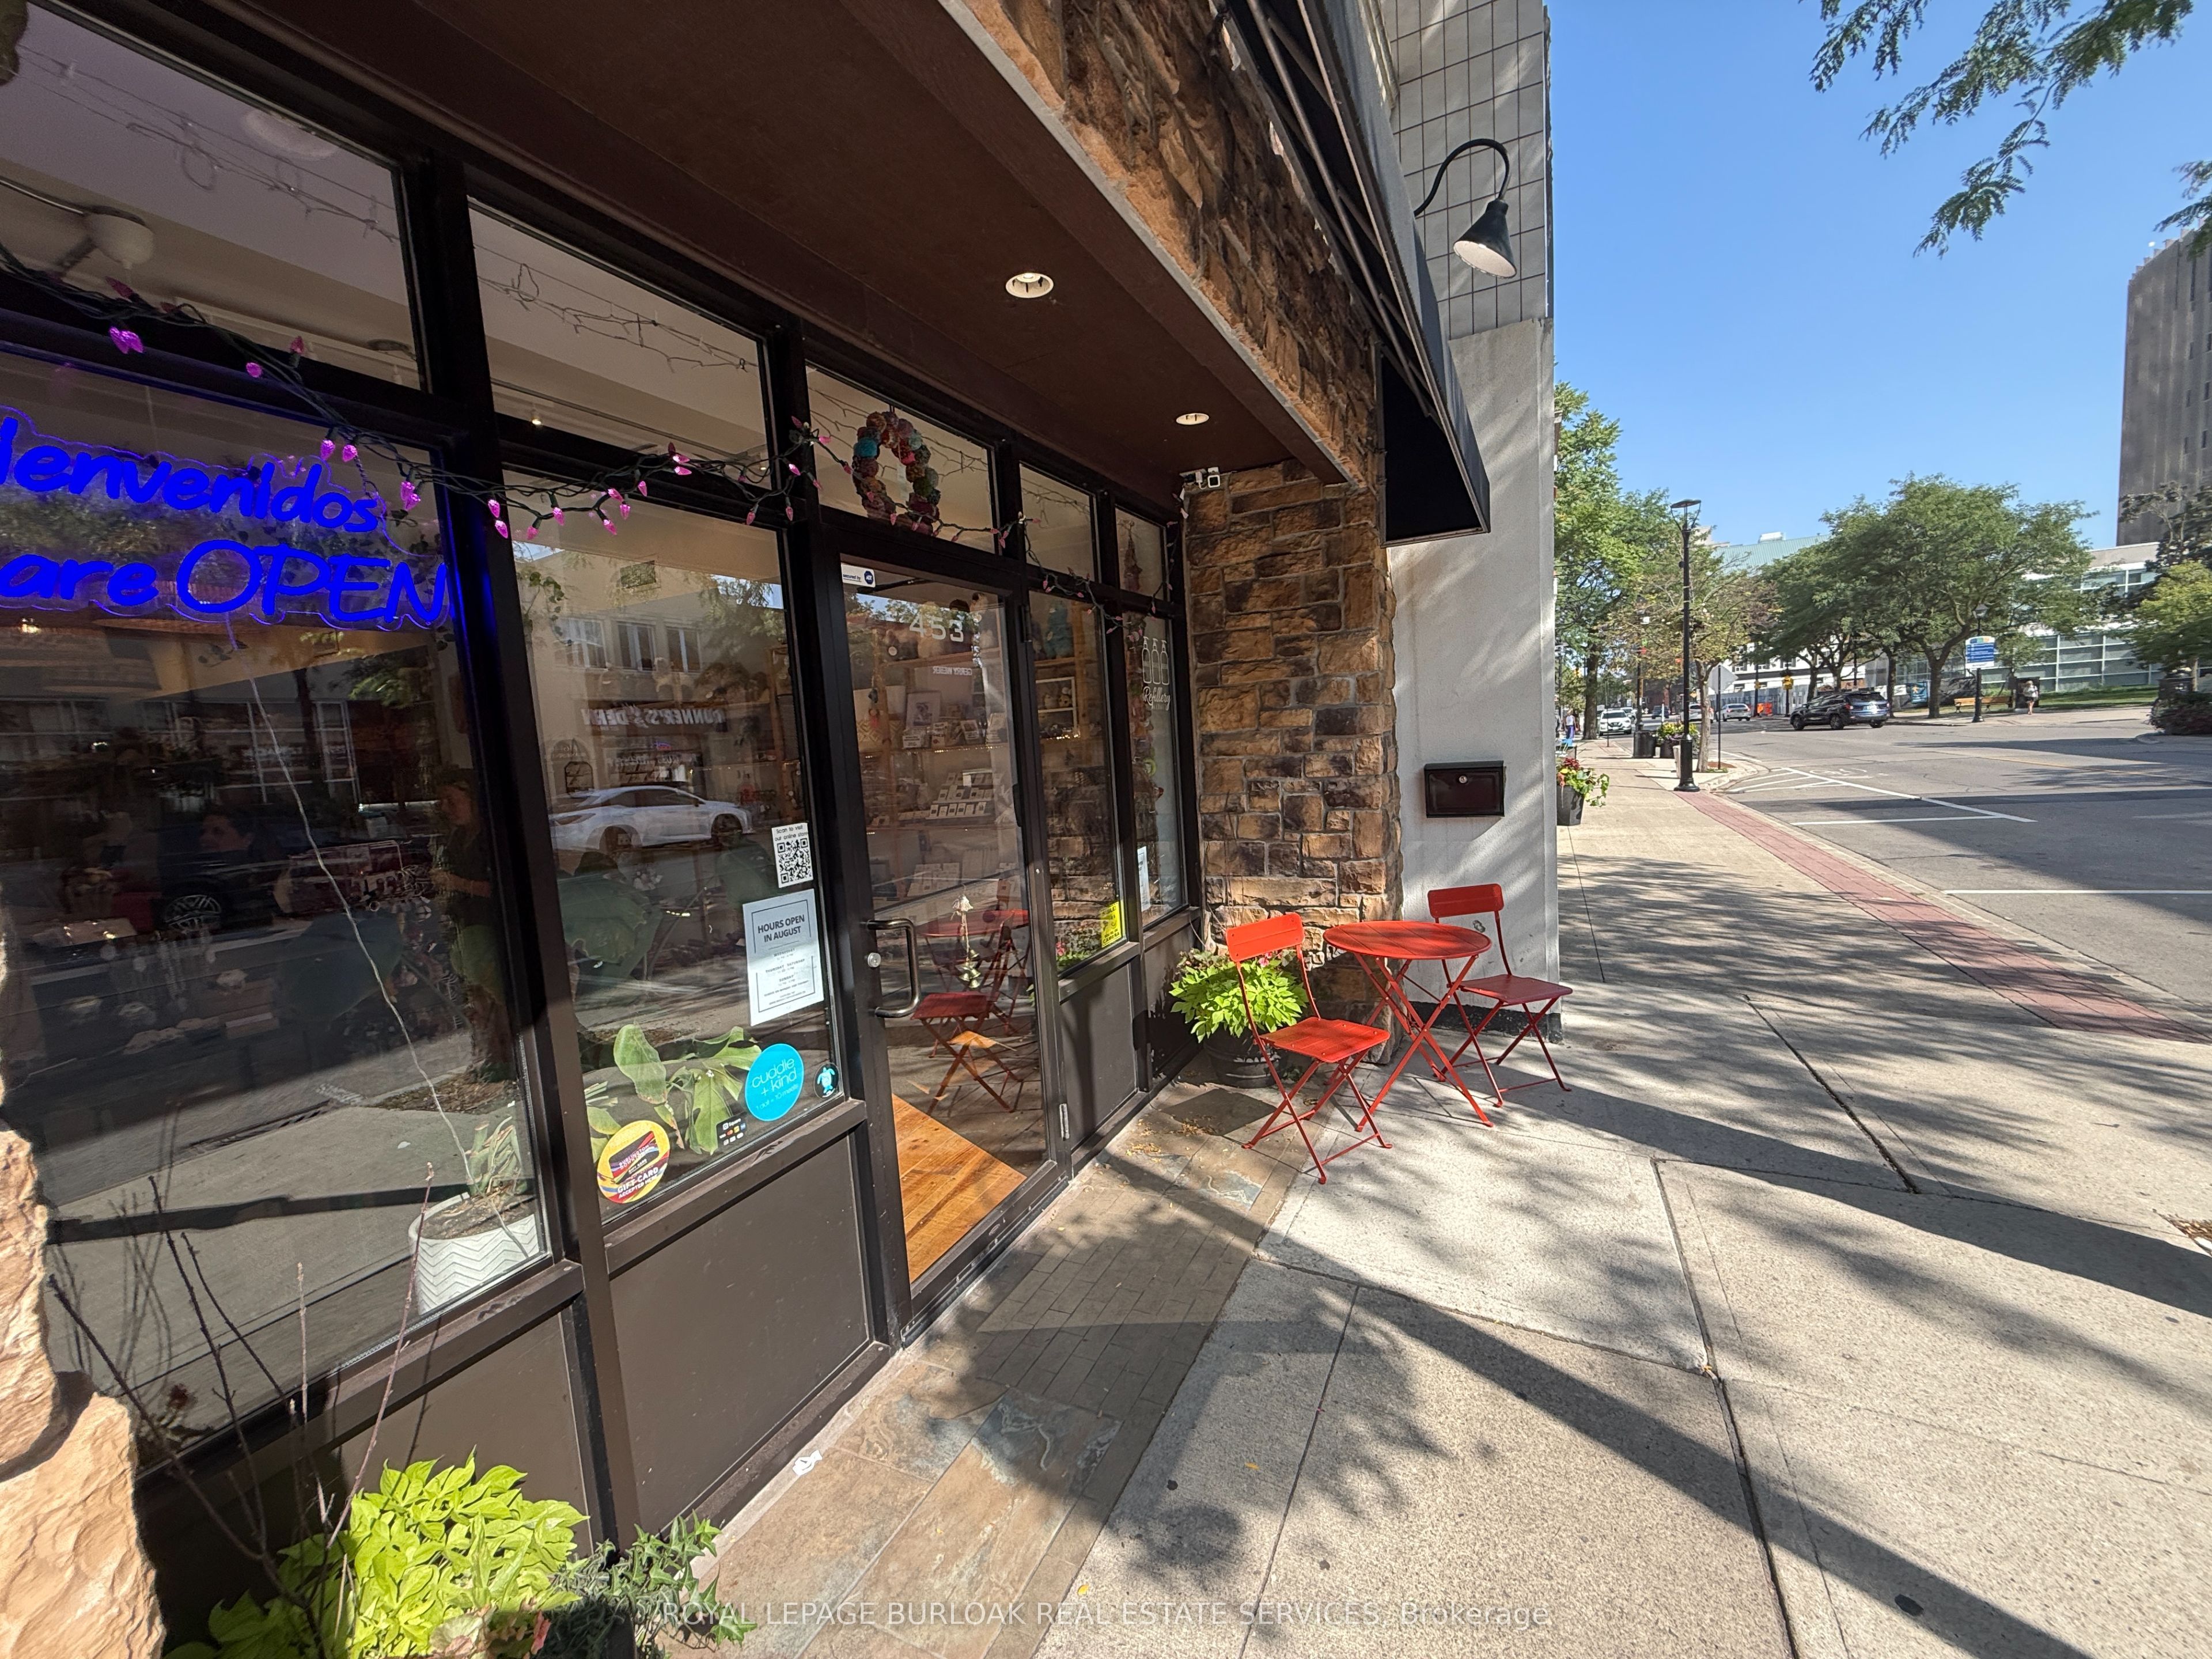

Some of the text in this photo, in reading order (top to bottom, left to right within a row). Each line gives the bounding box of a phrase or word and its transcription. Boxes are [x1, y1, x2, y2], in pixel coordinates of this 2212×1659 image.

[0, 539, 448, 623] are OPEN
[910, 612, 964, 642] 453
[1143, 686, 1171, 711] Refillery
[757, 914, 805, 934] HOURS OPEN
[764, 926, 801, 942] IN AUGUST
[752, 1058, 795, 1088] cuddle
[770, 1067, 797, 1092] kind
[618, 1179, 636, 1194] GIFT
[637, 1167, 658, 1182] CARD
[618, 1183, 645, 1199] ACCEPTED
